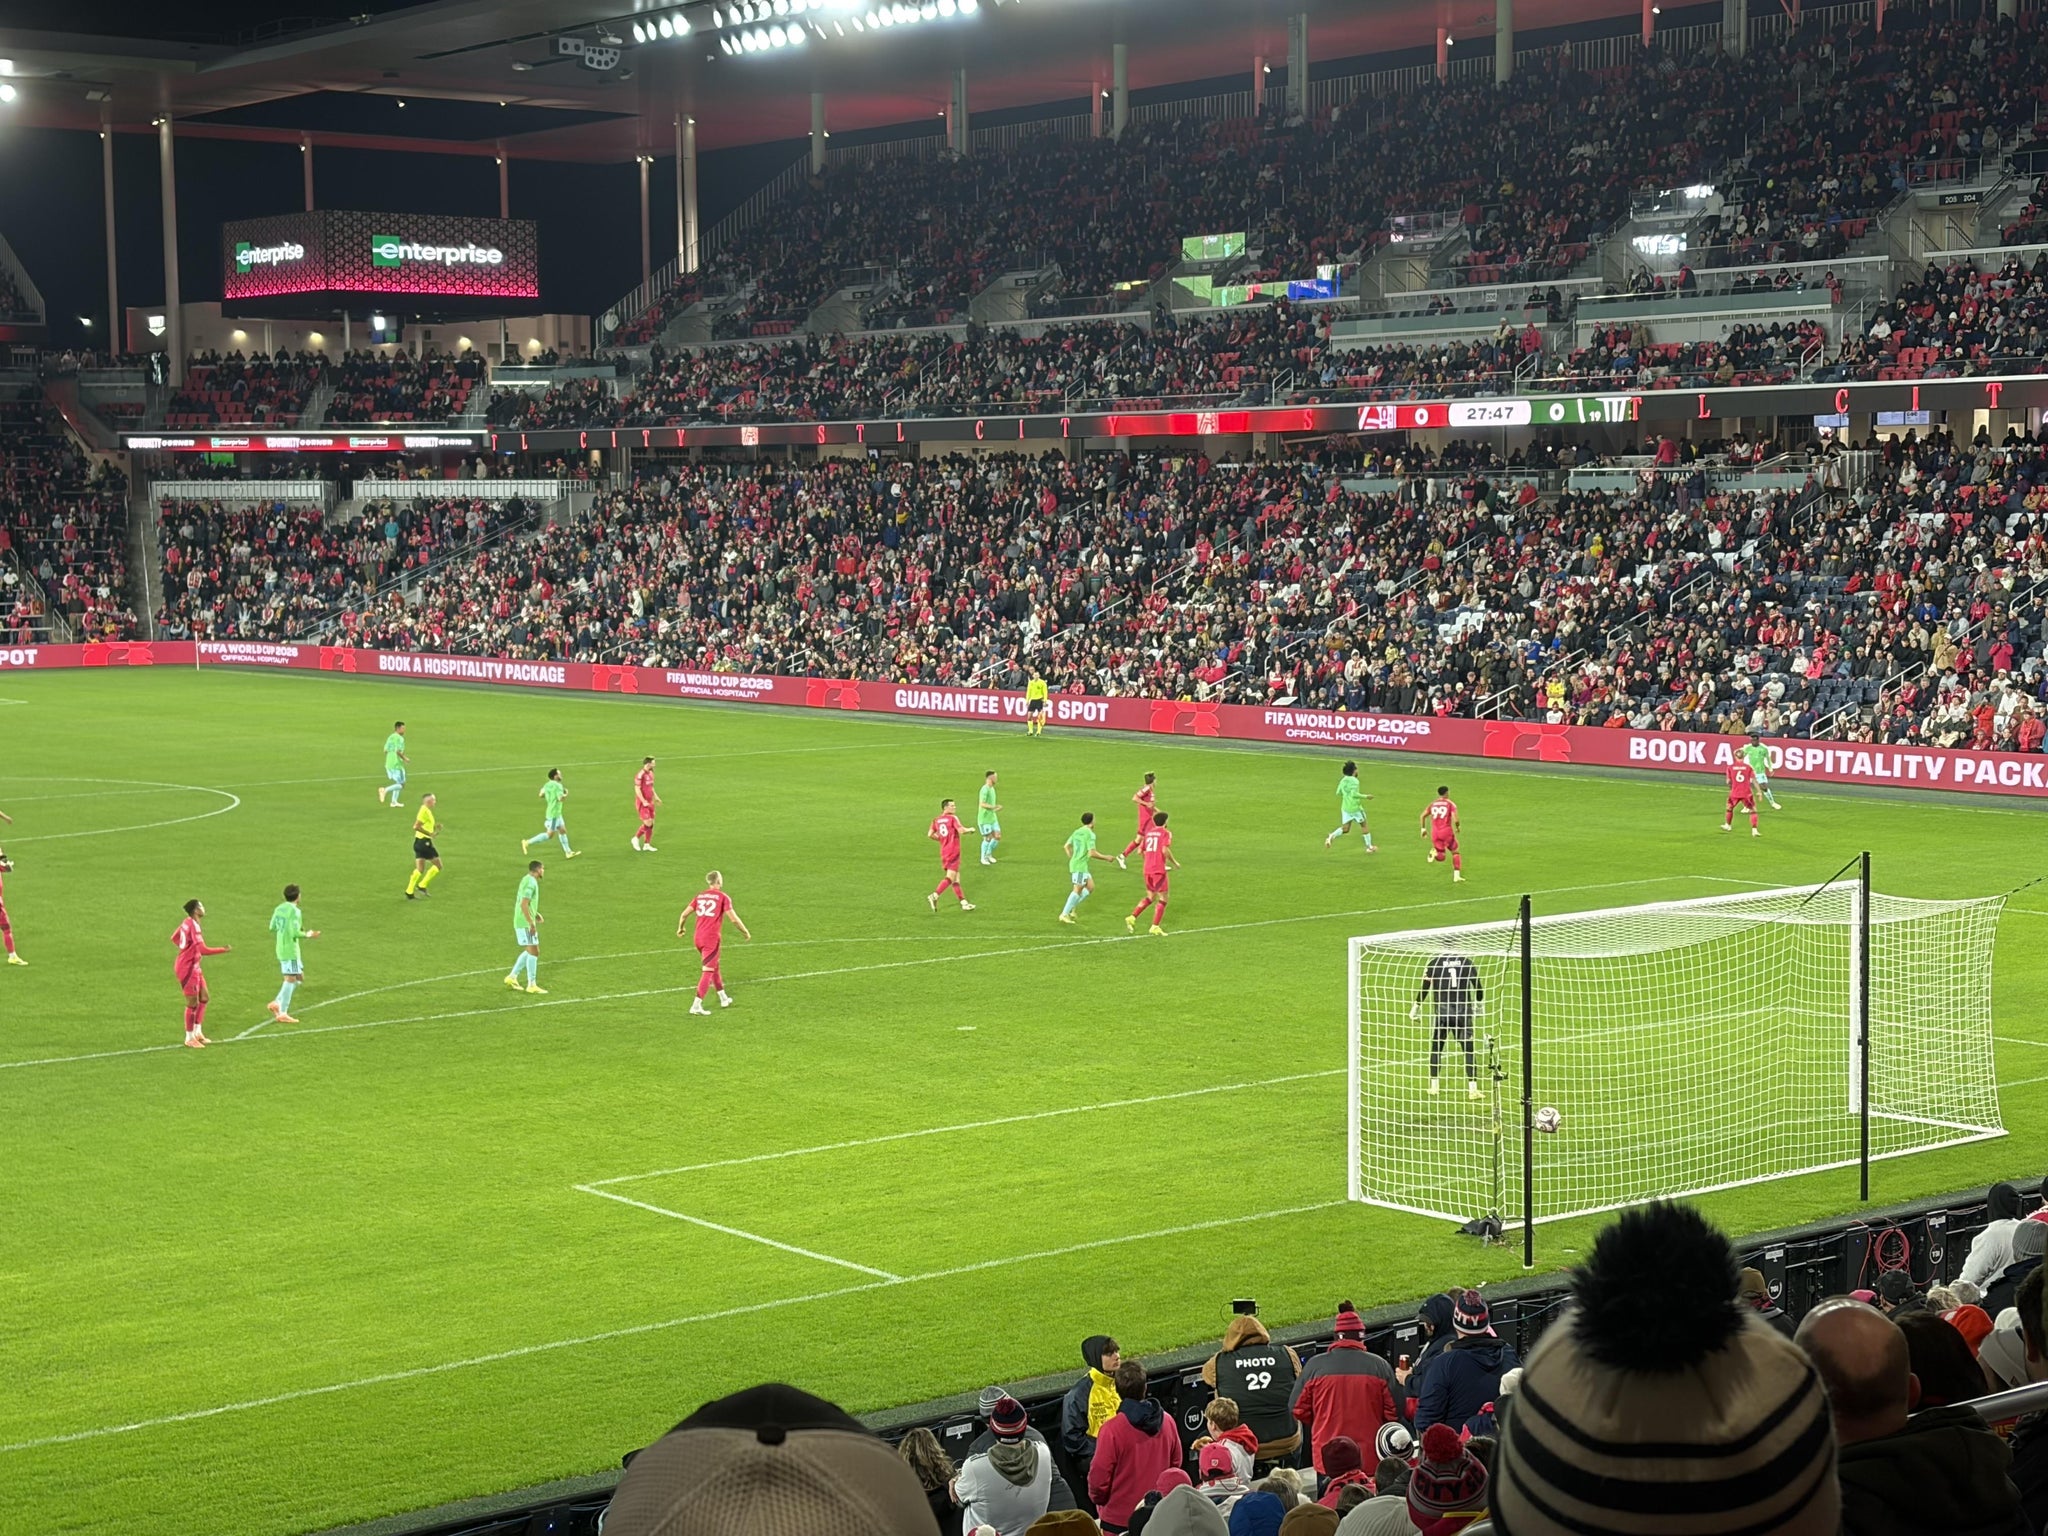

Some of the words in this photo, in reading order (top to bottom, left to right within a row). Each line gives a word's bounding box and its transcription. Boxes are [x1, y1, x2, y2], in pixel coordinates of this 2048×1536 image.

[236, 241, 304, 266] enterprise
[374, 244, 503, 266] enterprise
[1415, 408, 1428, 425] 0
[1467, 406, 1514, 420] 27:47
[1549, 402, 1565, 421] 0
[1589, 410, 1602, 422] 19
[1708, 472, 1742, 483] CLUB
[200, 643, 228, 654] FIFA
[228, 644, 262, 654] WORLD
[262, 646, 275, 656] CUP
[221, 654, 256, 663] OFFICIAL
[379, 654, 411, 672] BOOK
[413, 656, 421, 672] A
[424, 658, 502, 678] HOSPITALITY
[505, 664, 565, 683] PACKAGE
[666, 672, 686, 684] FIFA
[686, 673, 720, 687] WORLD
[720, 676, 739, 688] CUP
[739, 677, 774, 691] 2026
[680, 686, 713, 696] OFFICIAL
[713, 688, 760, 699] HOSPITALITY
[895, 689, 999, 714] GUARANTEE
[1003, 696, 1054, 719] YOR
[1057, 700, 1109, 722] SPOT
[1265, 711, 1294, 726] FIFA
[1295, 713, 1345, 730] WORLD
[1347, 716, 1376, 732] CUP
[1377, 718, 1431, 735] 2026
[1285, 728, 1334, 741] OFFICIAL
[1335, 732, 1408, 746] HOSPITALITY
[1629, 737, 1706, 765] BOOK
[1713, 742, 1734, 766] A
[1743, 744, 1946, 781] OSPITALITY
[1954, 757, 2048, 789] PACK
[1735, 770, 1745, 783] 6
[1430, 805, 1448, 819] 99
[1145, 836, 1159, 852] 21
[696, 899, 717, 917] 32
[1448, 967, 1458, 988] 1
[1235, 1357, 1276, 1369] PHOTO
[1245, 1371, 1272, 1391] 29
[1188, 1414, 1199, 1423] TGI
